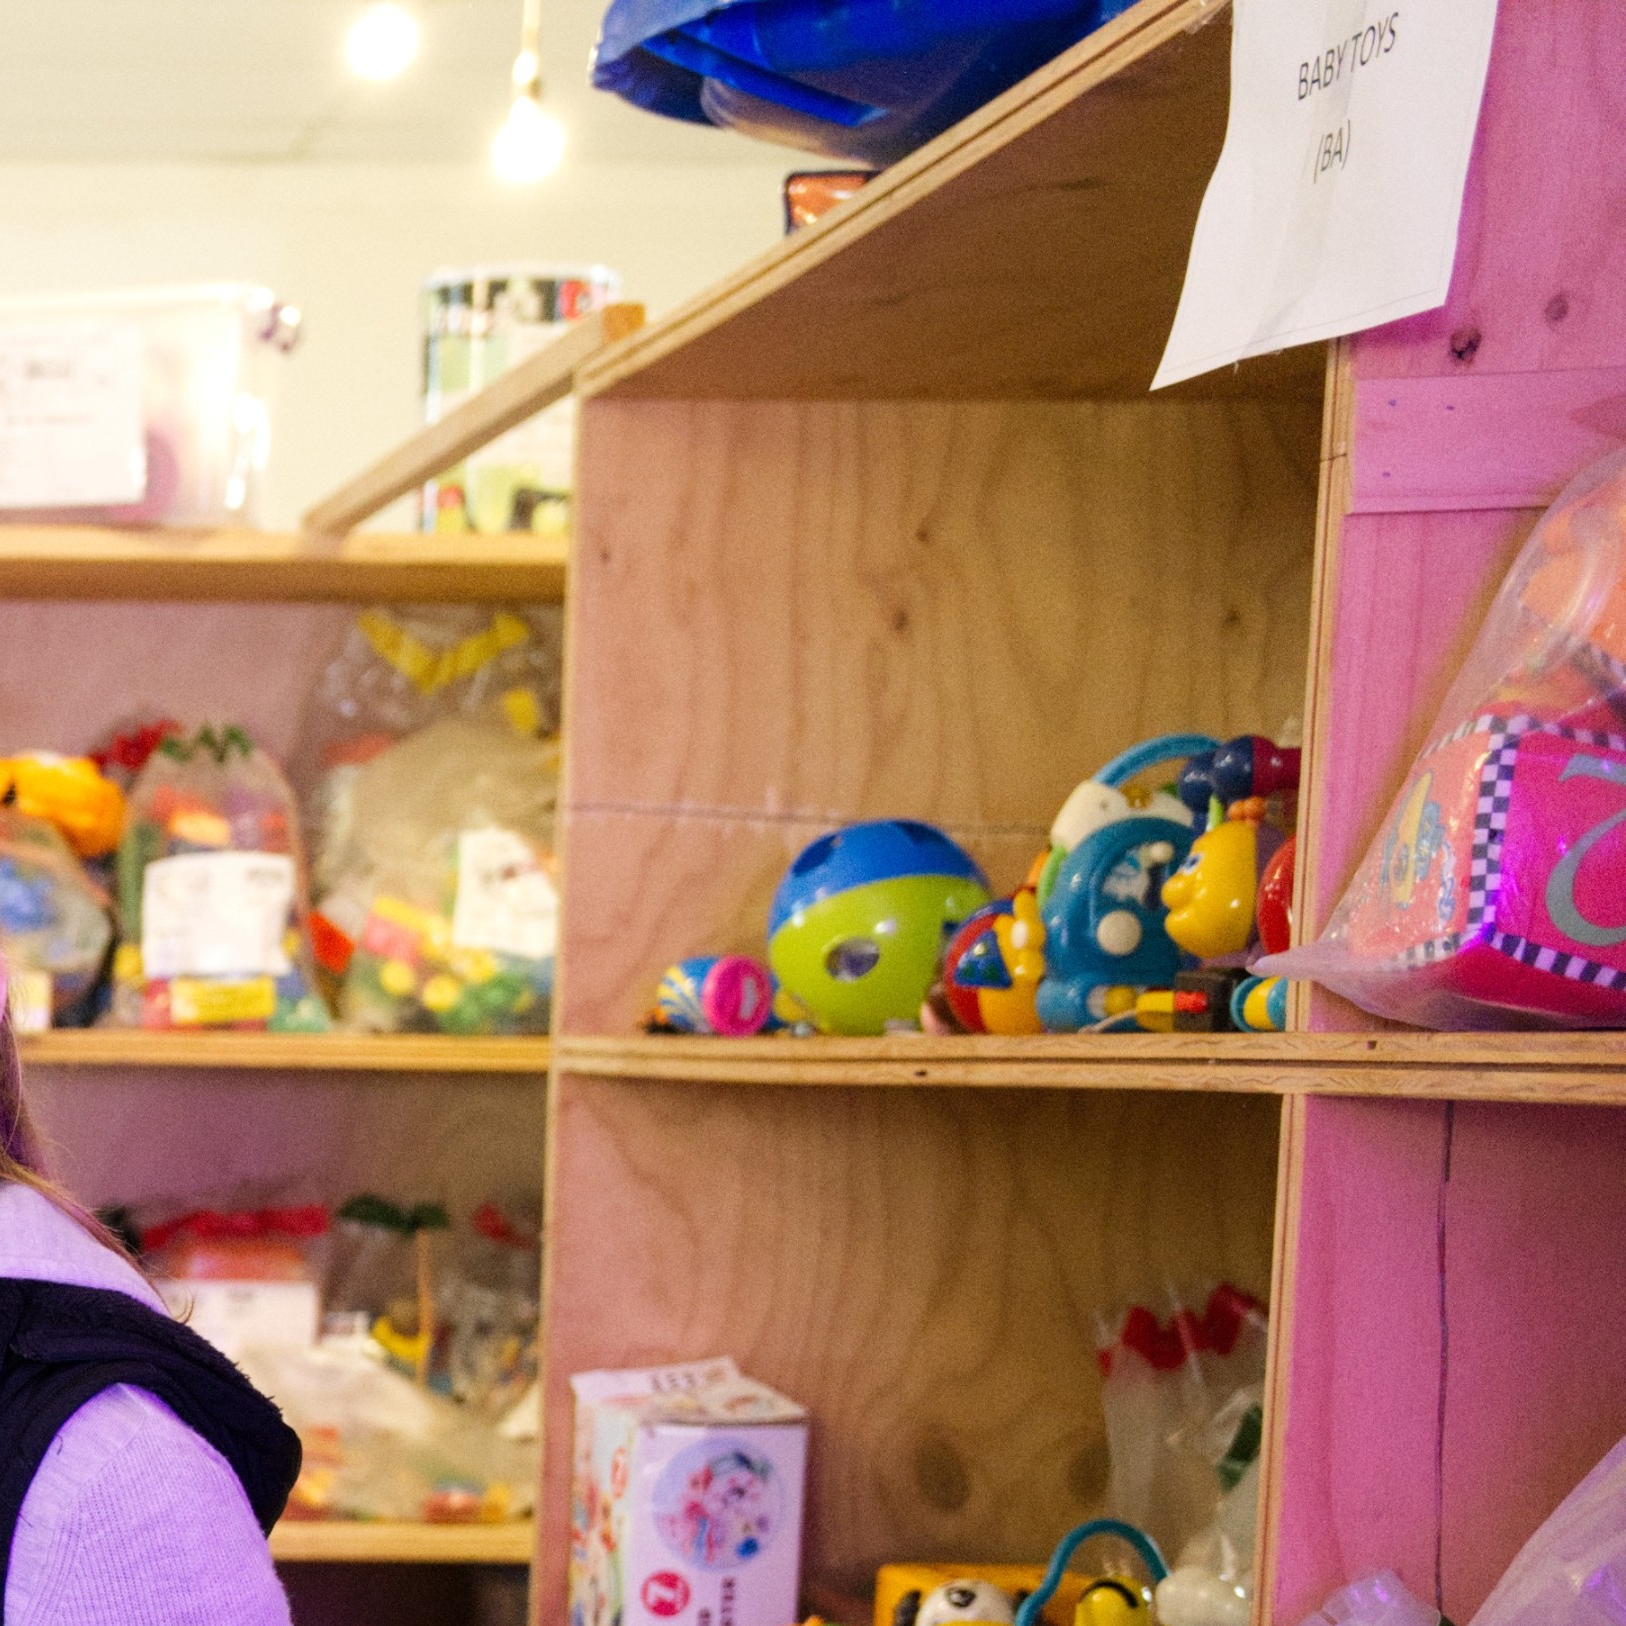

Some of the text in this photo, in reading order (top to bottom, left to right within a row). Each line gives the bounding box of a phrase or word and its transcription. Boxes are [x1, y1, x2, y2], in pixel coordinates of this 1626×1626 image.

[1298, 12, 1399, 101] BABY TOYS
[1313, 118, 1351, 184] (BA)
